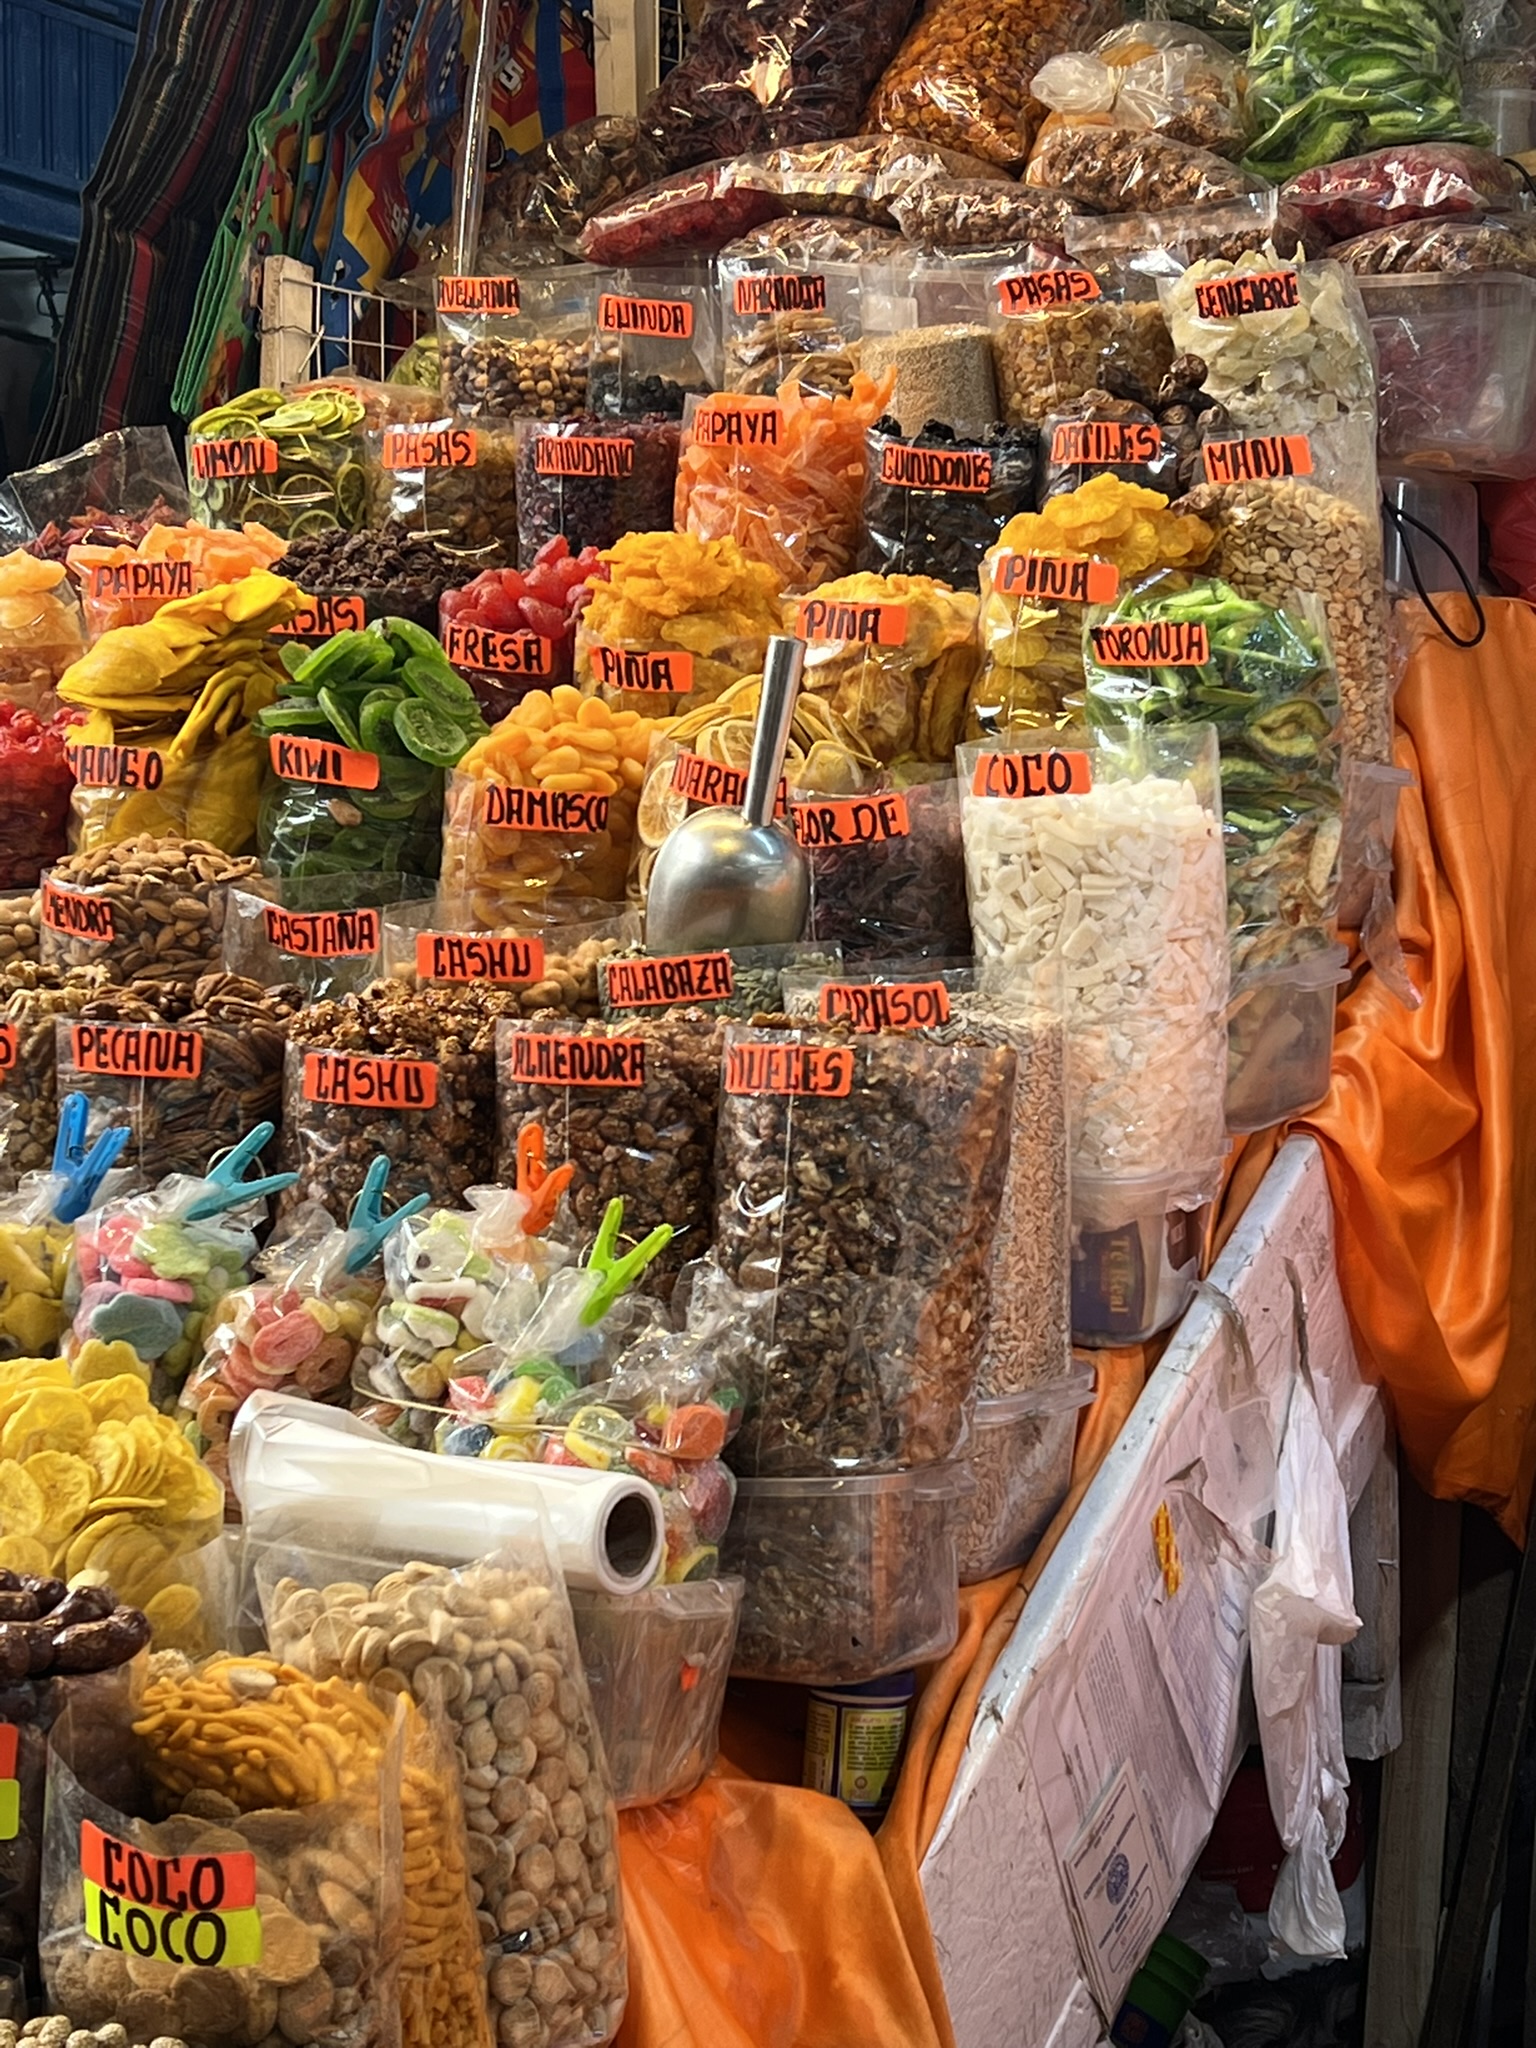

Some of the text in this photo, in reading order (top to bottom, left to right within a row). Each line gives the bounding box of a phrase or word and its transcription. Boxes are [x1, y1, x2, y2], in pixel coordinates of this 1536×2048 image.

[1006, 271, 1091, 307] PASAS
[604, 298, 686, 335] GUINDA
[194, 441, 266, 479] LIMON
[391, 430, 472, 469] PASAS
[535, 437, 635, 475] ARANDANO
[1054, 423, 1158, 462] DATILES
[1208, 437, 1294, 481] MANI
[96, 561, 193, 598] PAPAYA
[1004, 556, 1089, 601] PIÑA
[804, 601, 881, 643] PIÑA
[1089, 622, 1203, 662] TORONJA
[448, 623, 547, 672] FRESA
[601, 650, 673, 691] PIÑA
[279, 742, 342, 781] KIWI
[986, 753, 1073, 795] COCO
[671, 754, 787, 818] NARAA
[486, 784, 609, 832] DAMASCO
[849, 799, 903, 841] DE
[268, 909, 375, 952] CASTAÑA
[434, 940, 532, 978] CASHU
[608, 954, 732, 1002] CALABAZA
[78, 1026, 198, 1073] PECANA
[514, 1038, 645, 1082] ALMENDRA
[727, 1048, 843, 1092] NUECES
[316, 1057, 424, 1104] CASHU
[103, 1838, 225, 1912] COCO
[99, 1889, 227, 1967] COCO
